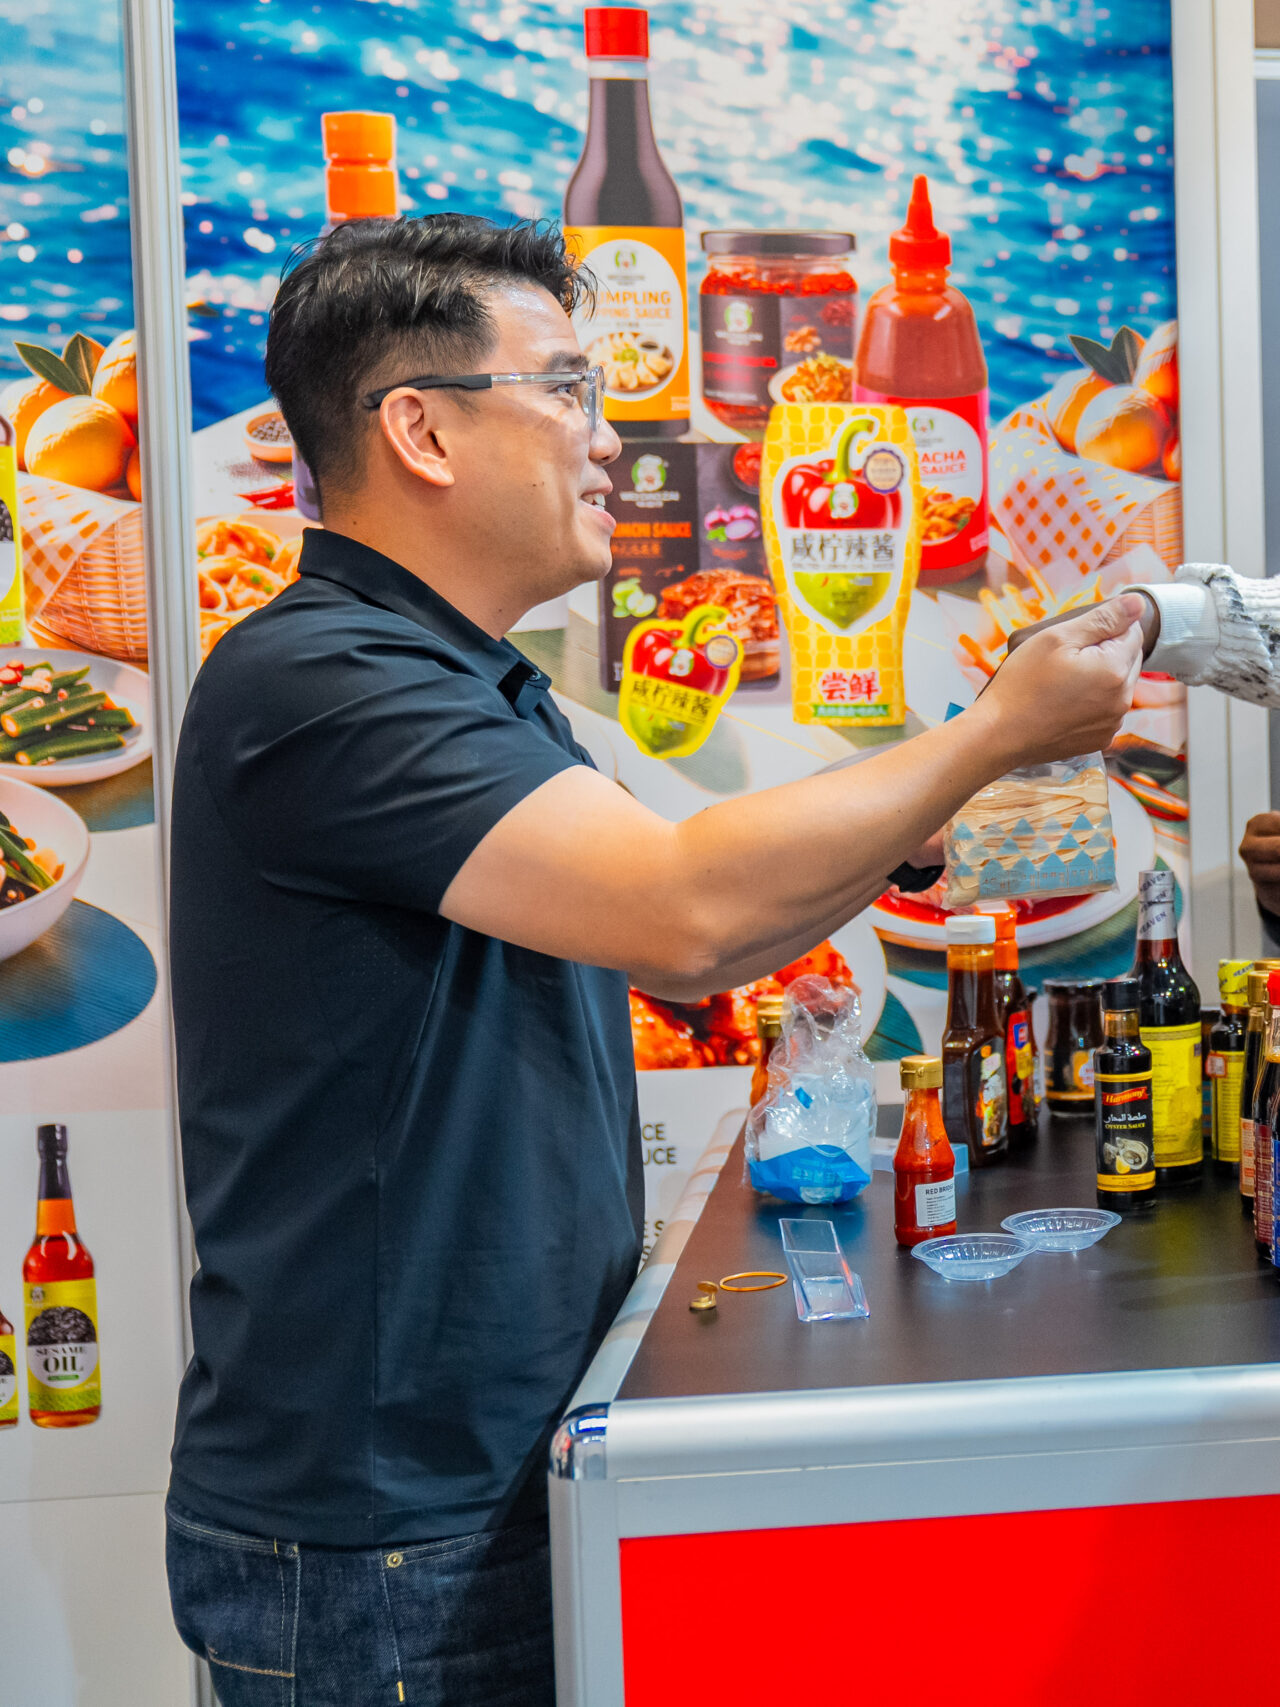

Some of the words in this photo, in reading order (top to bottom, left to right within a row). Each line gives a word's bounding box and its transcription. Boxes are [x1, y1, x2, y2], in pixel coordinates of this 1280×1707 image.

[920, 462, 967, 475] SAUCE
[822, 671, 878, 701] 尝鲜
[35, 1346, 87, 1356] SESAME
[43, 1355, 84, 1373] OIL
